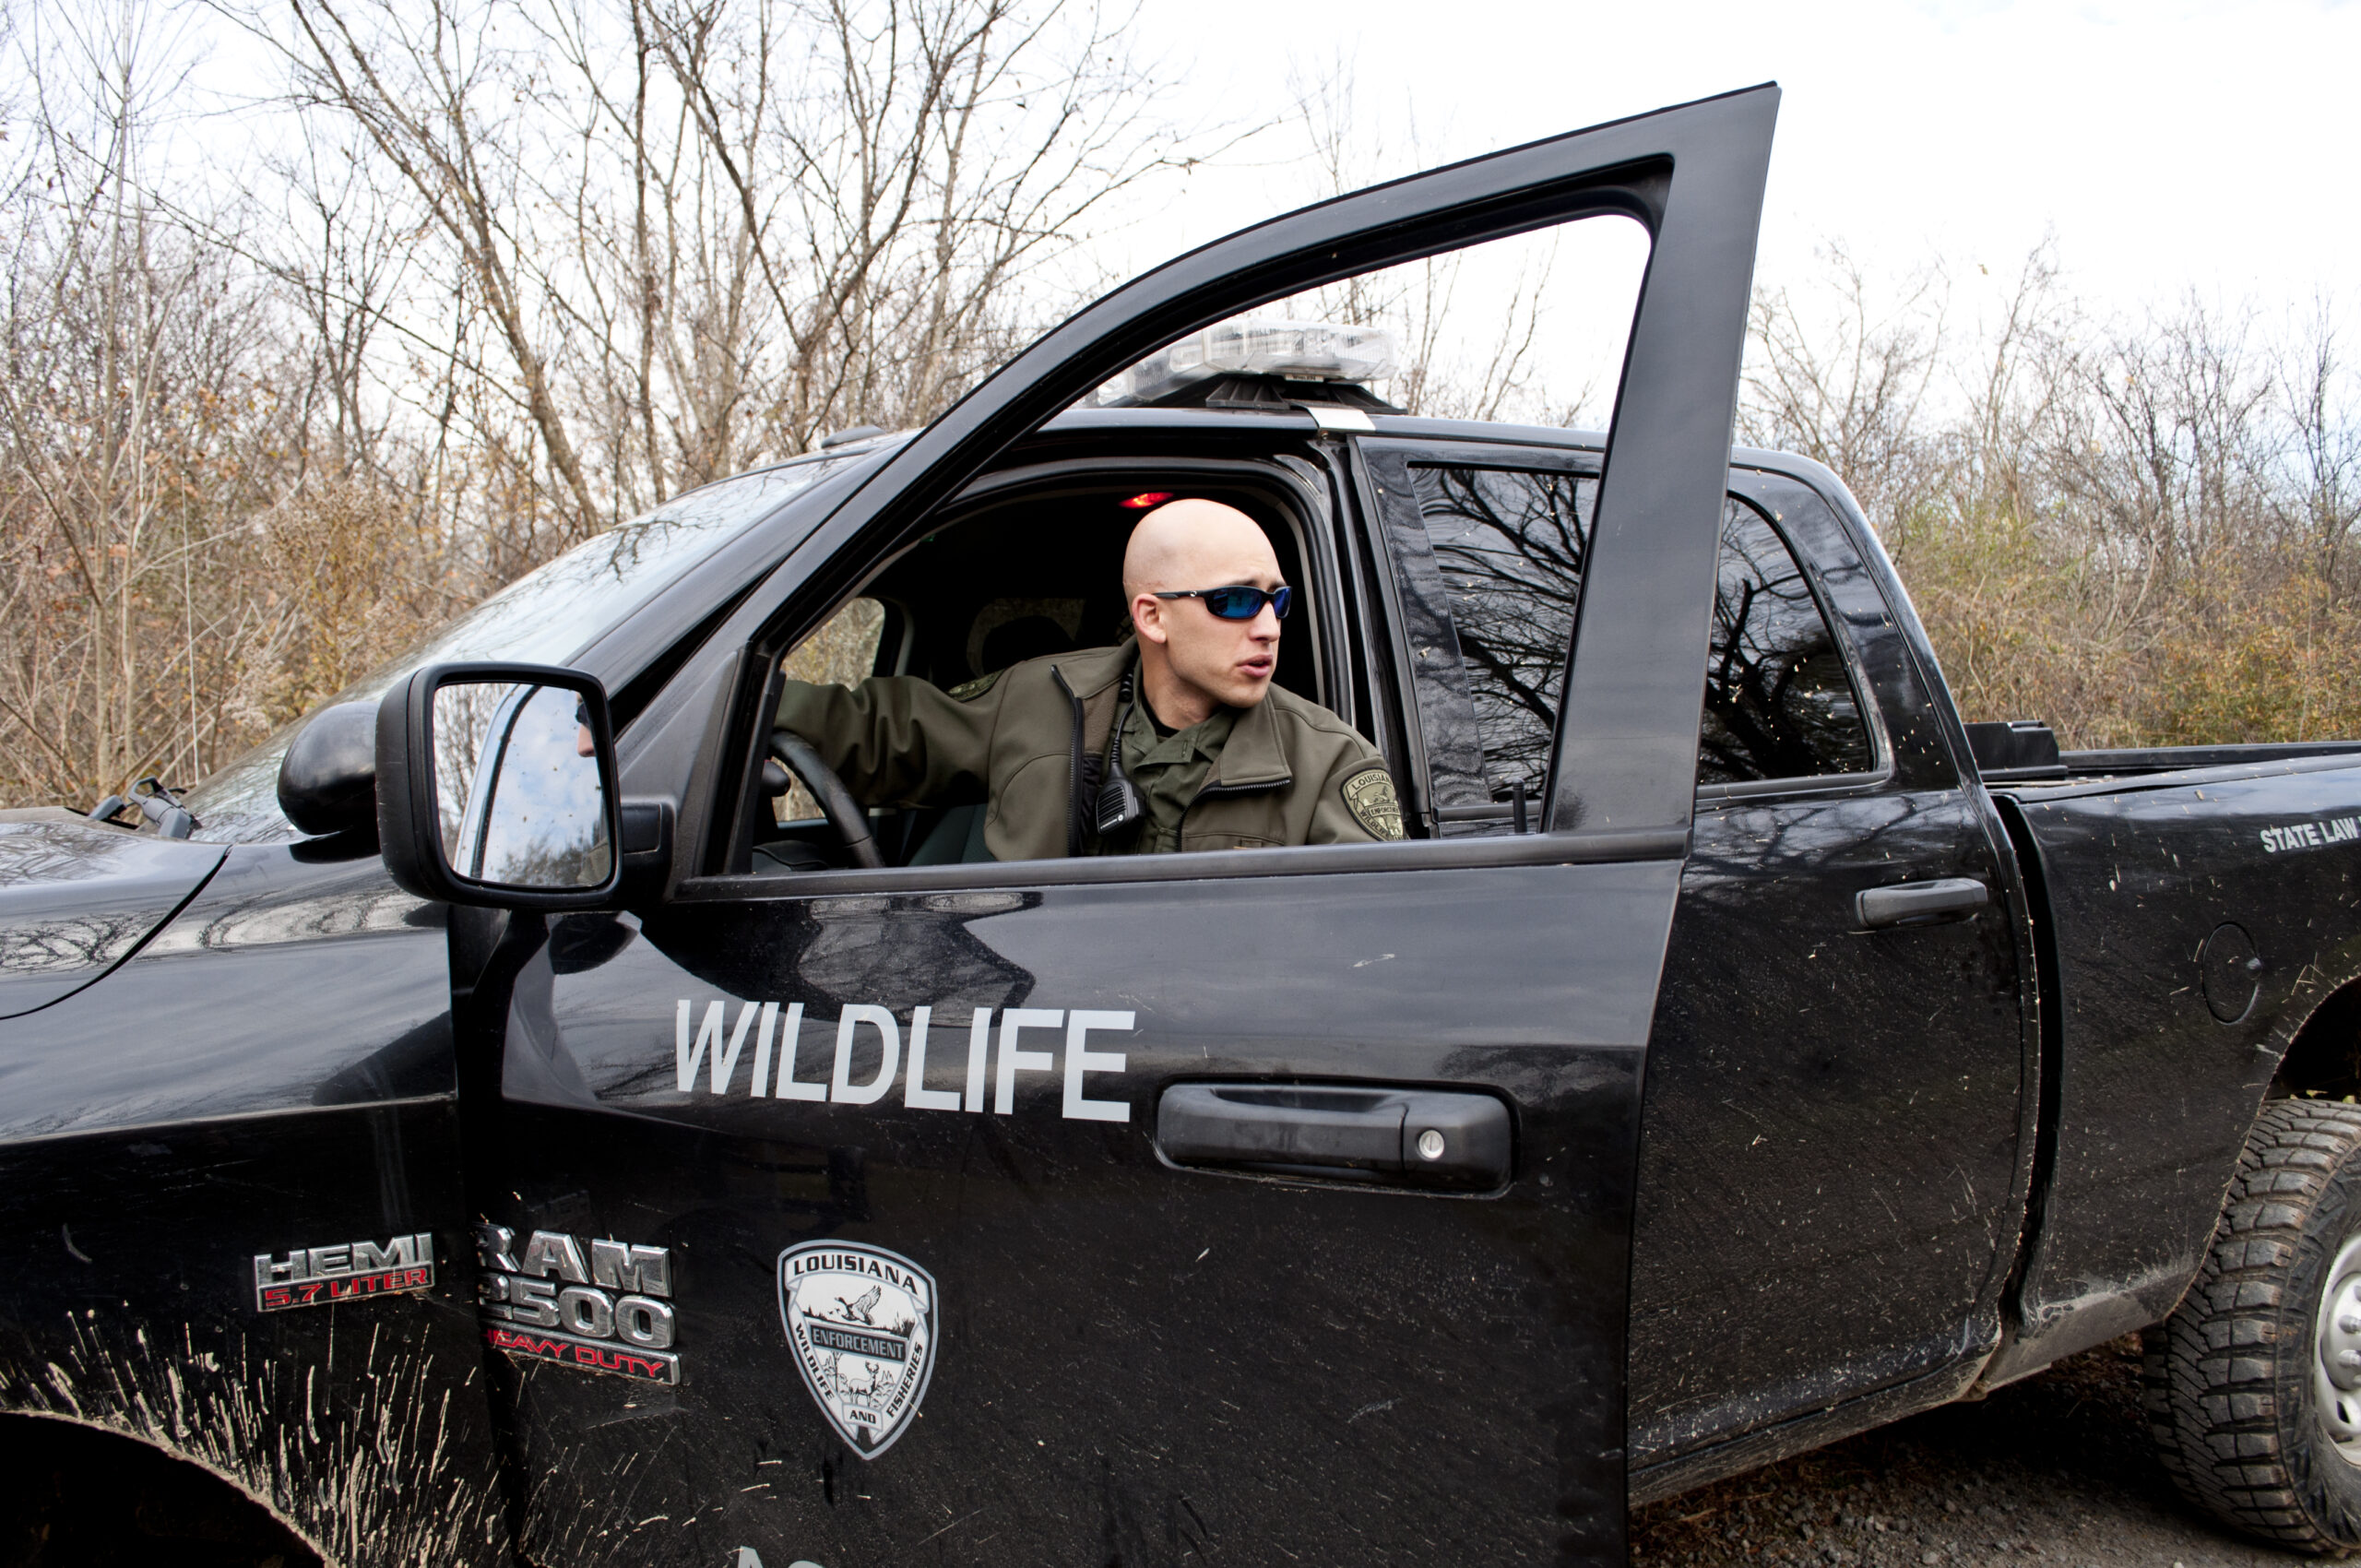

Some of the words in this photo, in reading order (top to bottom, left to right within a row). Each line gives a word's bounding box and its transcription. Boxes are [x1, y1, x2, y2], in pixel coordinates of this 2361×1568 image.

[1352, 773, 1393, 790] LOUISIAN
[2260, 824, 2320, 853] STATE
[2319, 817, 2359, 843] LAW
[676, 999, 1136, 1123] WILDLIFE
[254, 1232, 433, 1287] HEMI
[794, 1254, 919, 1295] LOUISIANA
[265, 1284, 323, 1307] 5.7
[330, 1268, 428, 1298] LITER
[575, 1344, 665, 1378] DUTY
[795, 1322, 836, 1402] WILDLIFE
[813, 1328, 904, 1360] ENFORCEMENT
[886, 1342, 923, 1419] FISHERIES
[849, 1409, 877, 1424] AND
